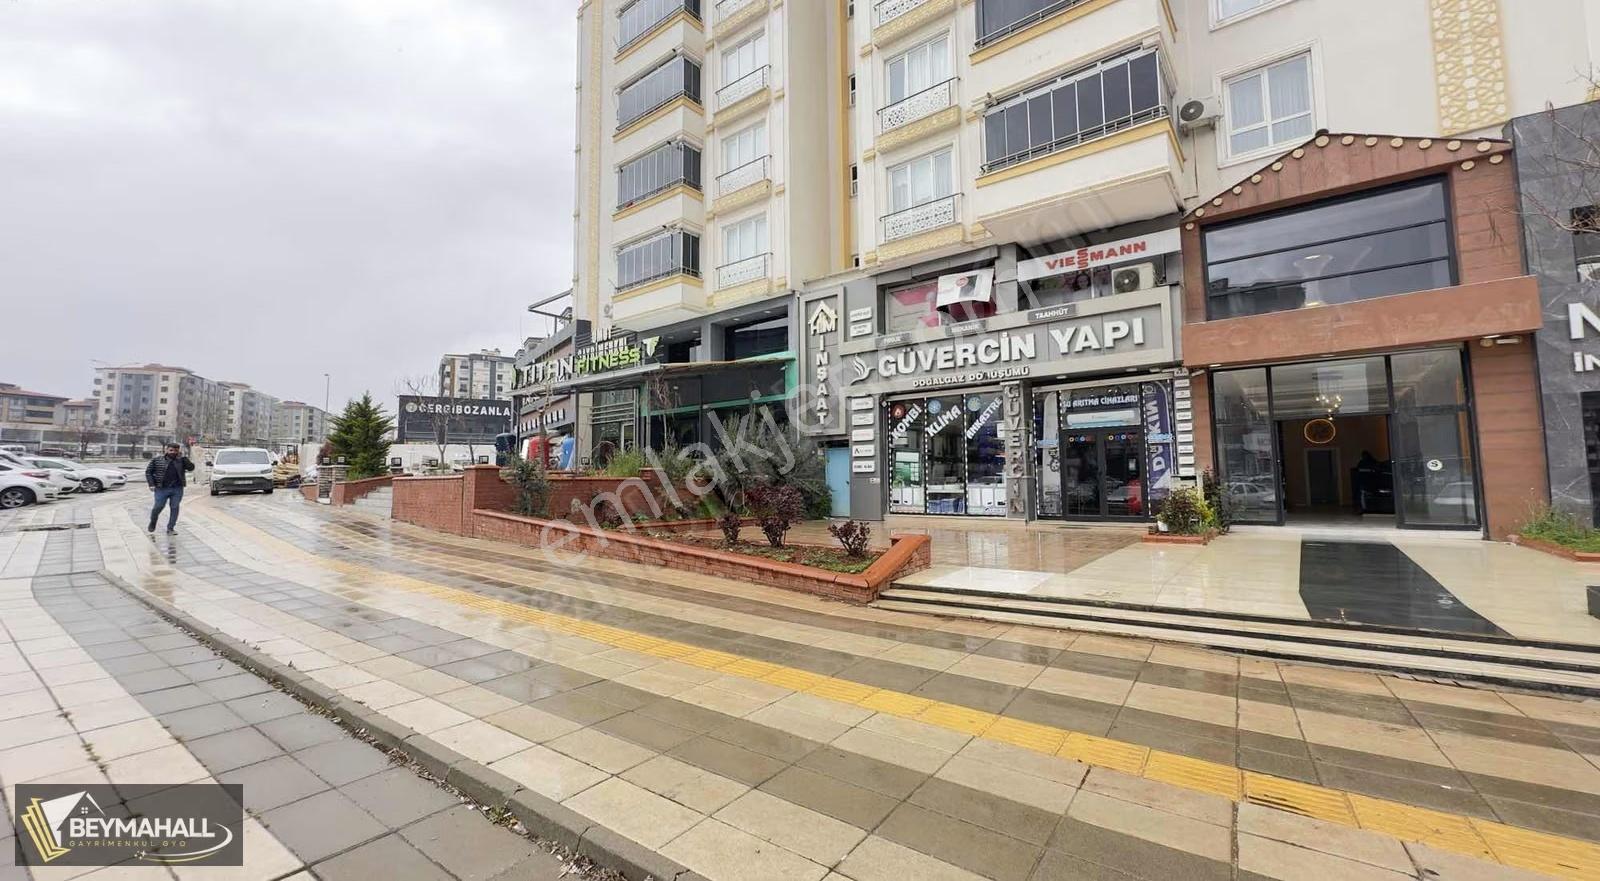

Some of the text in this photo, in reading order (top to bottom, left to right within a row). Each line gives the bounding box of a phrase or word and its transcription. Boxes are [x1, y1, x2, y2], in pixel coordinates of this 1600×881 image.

[878, 317, 1145, 378] GÜVERCİN YAPI
[926, 405, 962, 437] KLİMA
